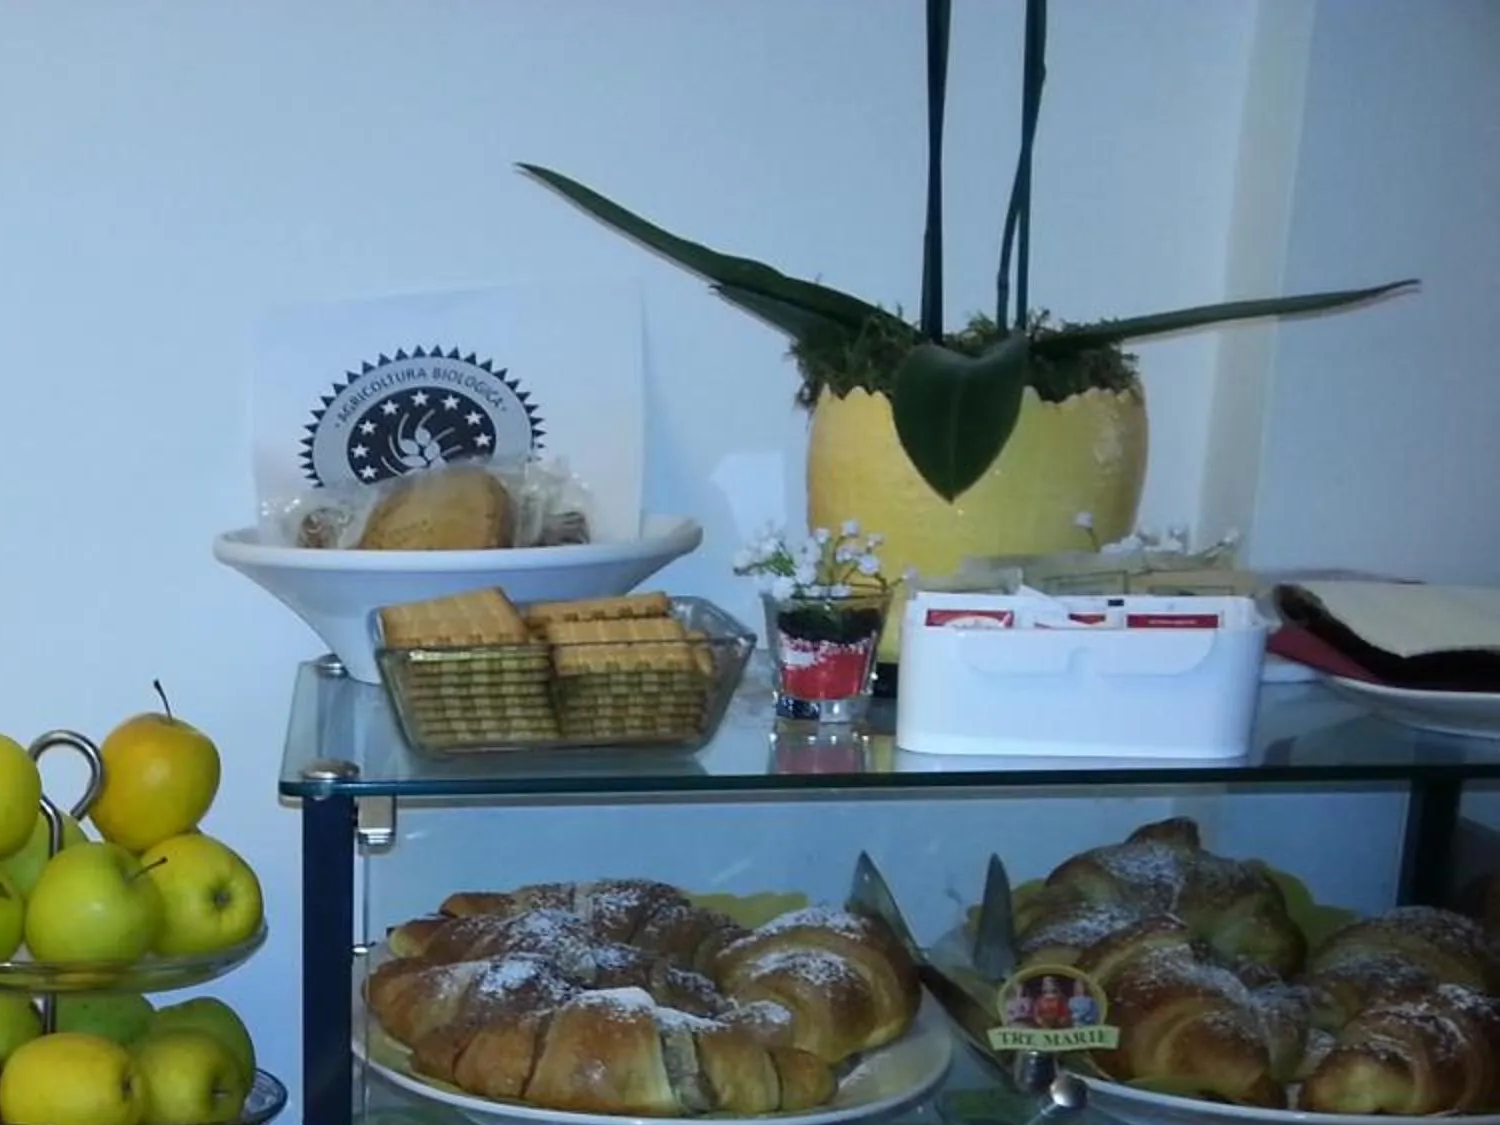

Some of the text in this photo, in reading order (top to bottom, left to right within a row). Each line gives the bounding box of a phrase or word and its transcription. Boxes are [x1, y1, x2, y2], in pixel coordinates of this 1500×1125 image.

[337, 366, 504, 424] AGRICOLTURA BIOLOGICA
[1000, 1029, 1108, 1046] TRE MARIE
